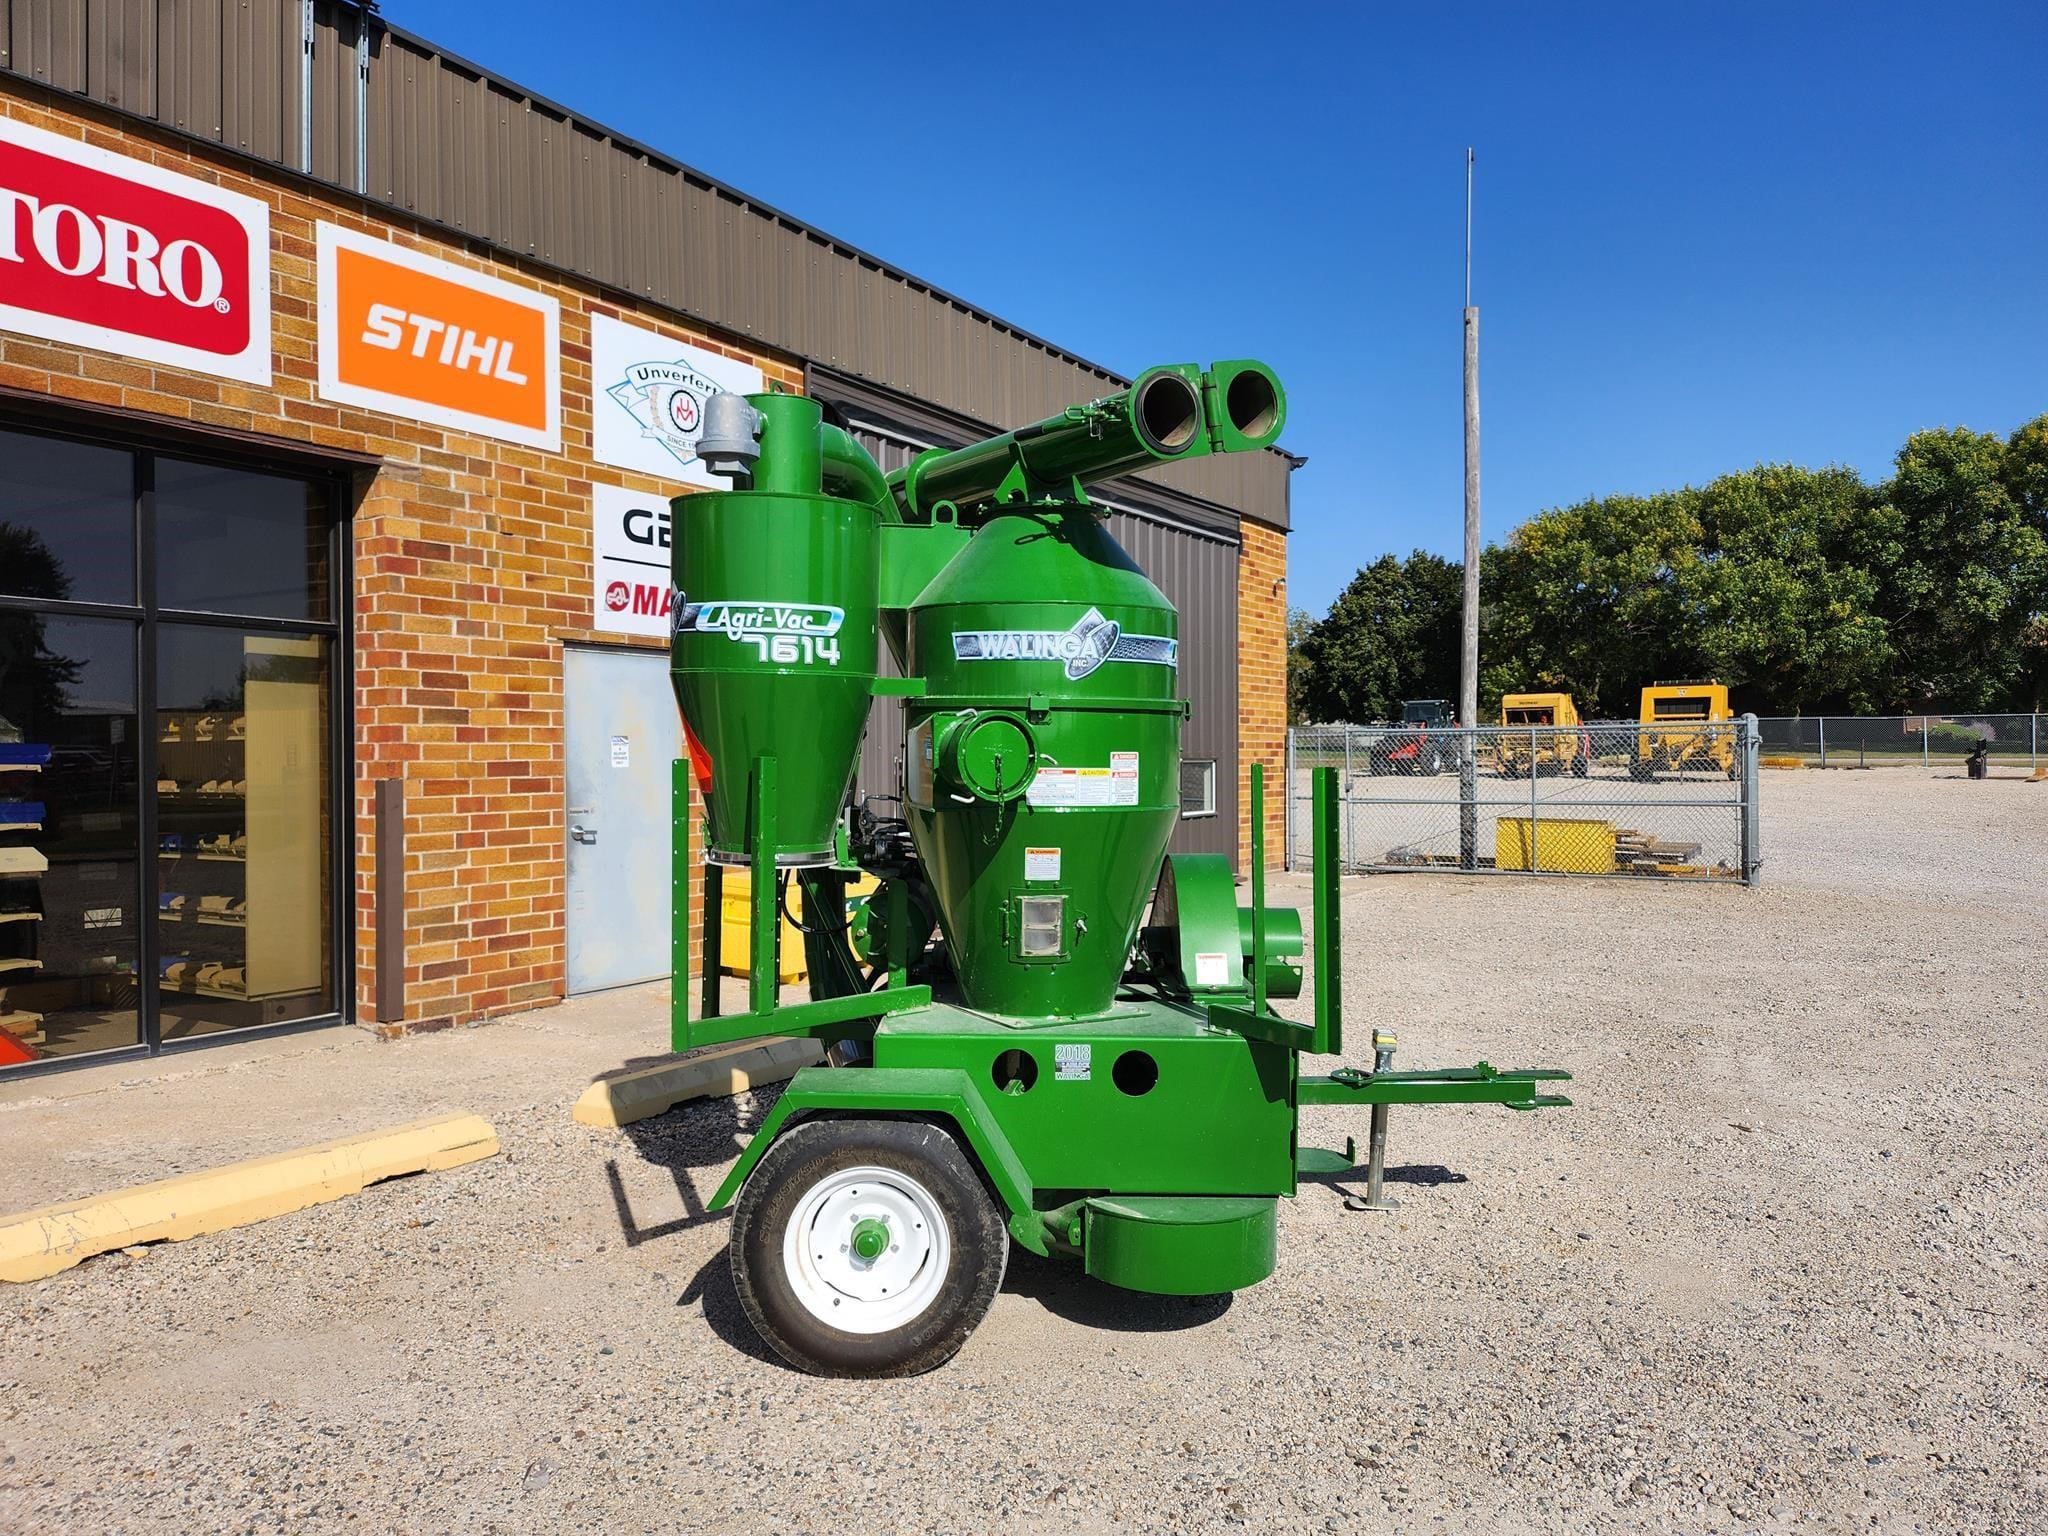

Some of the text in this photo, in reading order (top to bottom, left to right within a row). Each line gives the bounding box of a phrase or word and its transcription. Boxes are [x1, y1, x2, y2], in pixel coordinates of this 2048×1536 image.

[361, 303, 528, 386] STIHL
[667, 435, 688, 448] SINCE
[717, 607, 814, 641] Agri-Vac
[741, 634, 841, 666] 7614
[978, 632, 1102, 660] WALINGA
[1072, 658, 1089, 668] INC.
[1056, 1045, 1090, 1061] 2018
